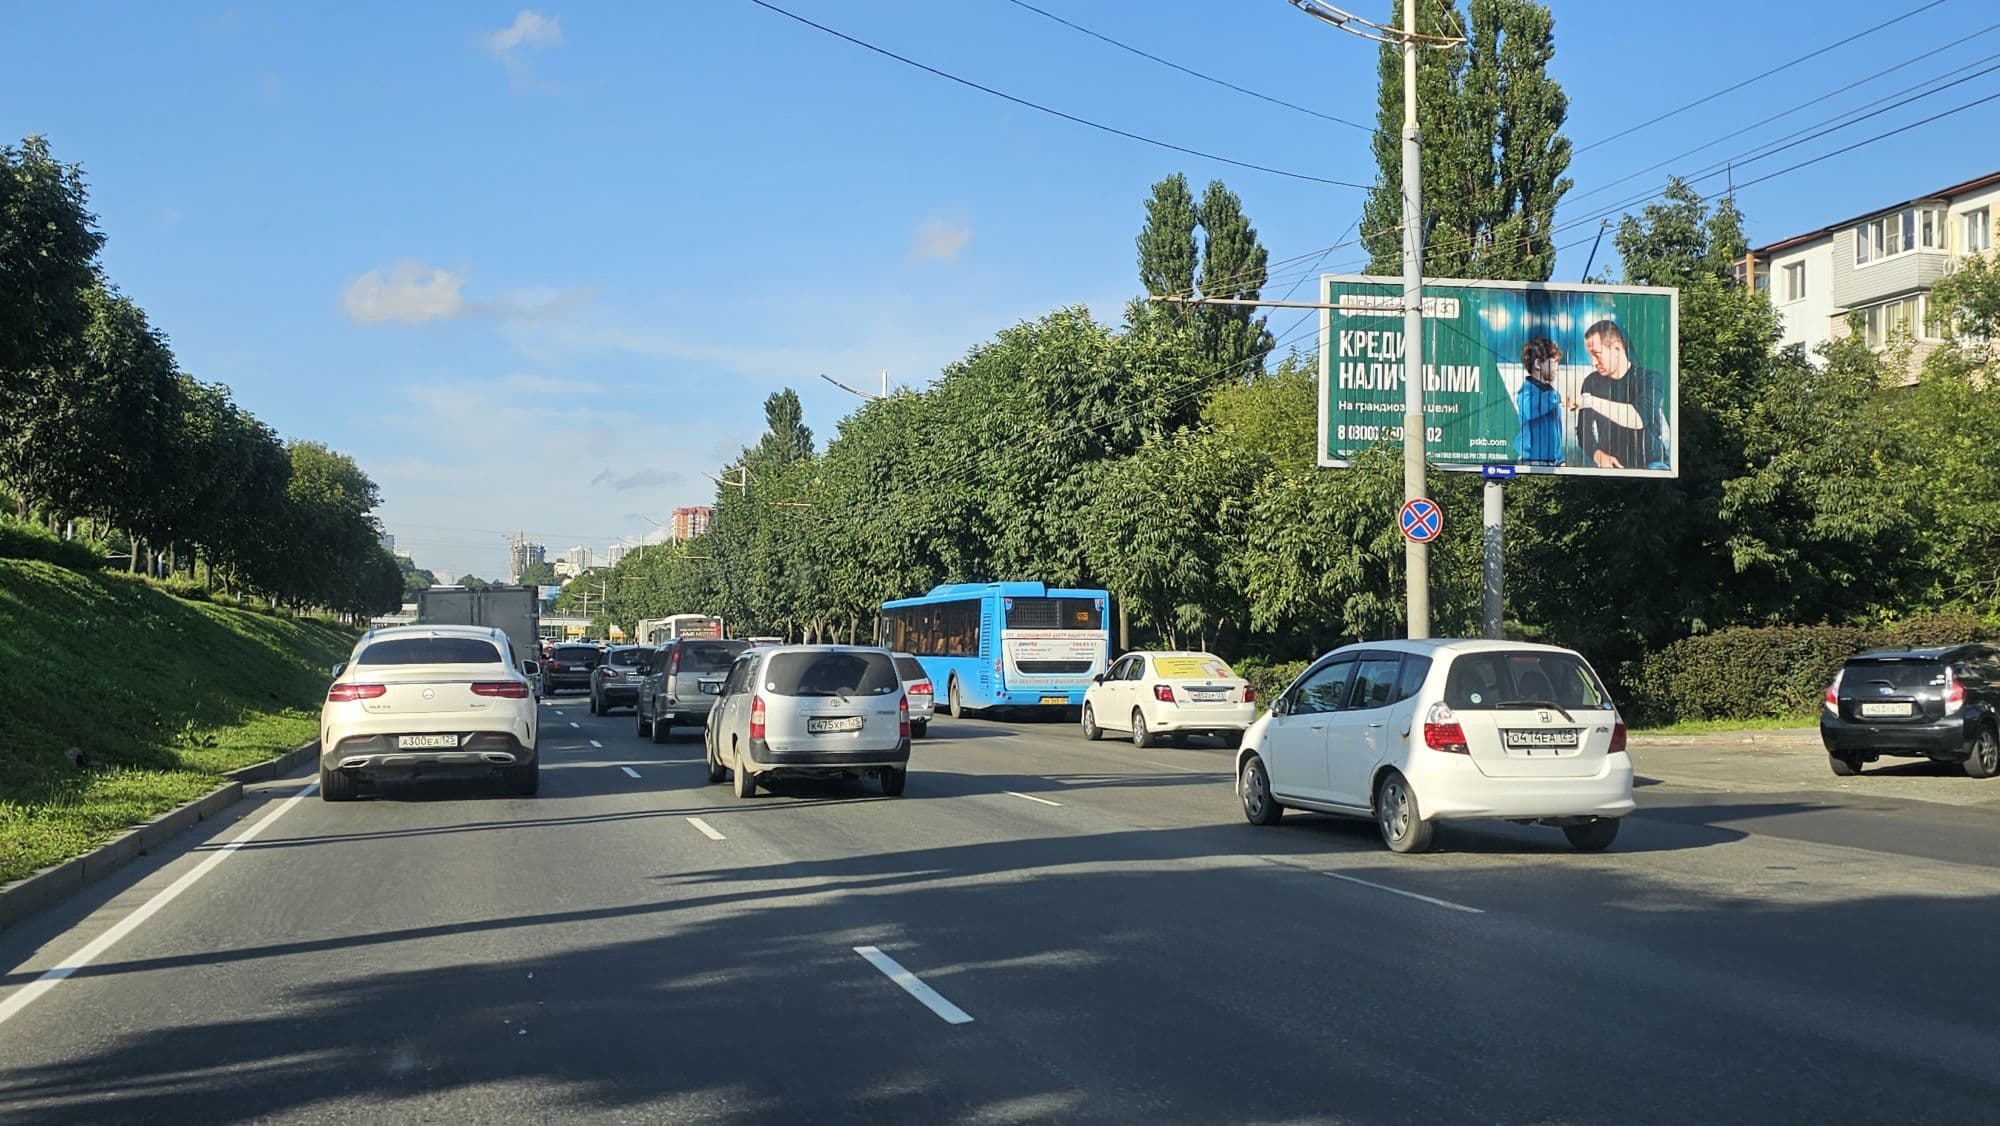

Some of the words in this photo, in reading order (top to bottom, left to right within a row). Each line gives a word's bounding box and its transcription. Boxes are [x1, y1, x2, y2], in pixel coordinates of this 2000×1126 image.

[1339, 330, 1407, 362] КРЕДИ
[1339, 362, 1480, 393] НАЛИЧЫМИ
[1338, 400, 1353, 411] На
[1356, 402, 1426, 413] грандиоз
[1427, 403, 1459, 414] цели!
[1337, 425, 1346, 440] 8
[1470, 438, 1507, 448] pskb.com
[810, 718, 845, 730] К475ХР
[848, 716, 861, 728] 125
[402, 736, 440, 746] А300ЕА
[441, 735, 455, 744] 125
[1512, 731, 1556, 743] О414ЕА
[1559, 730, 1575, 740] 125
